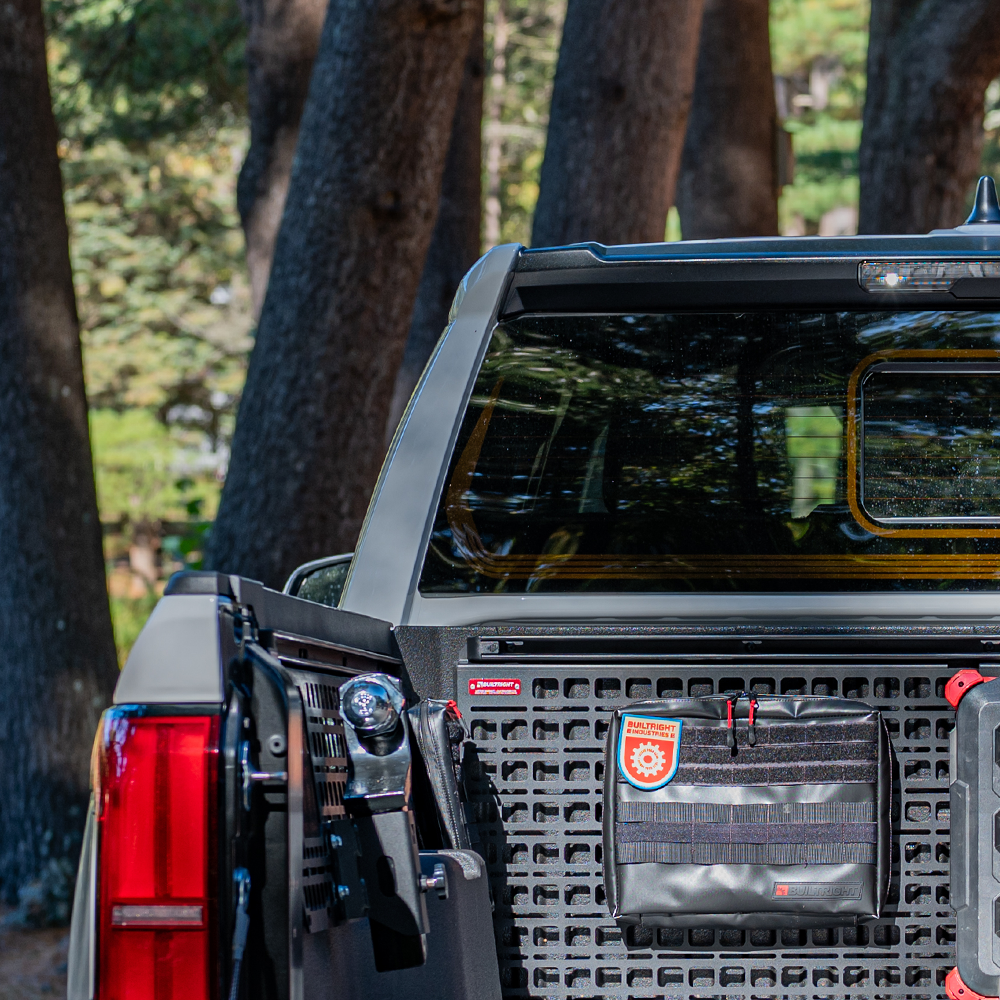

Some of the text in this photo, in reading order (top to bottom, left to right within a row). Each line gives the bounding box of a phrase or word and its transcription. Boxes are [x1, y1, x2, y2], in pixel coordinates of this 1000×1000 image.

[627, 720, 676, 732] BUILTRIGHT
[632, 728, 669, 738] INDUSTRIES
[788, 885, 859, 897] BUILTRIGHT
